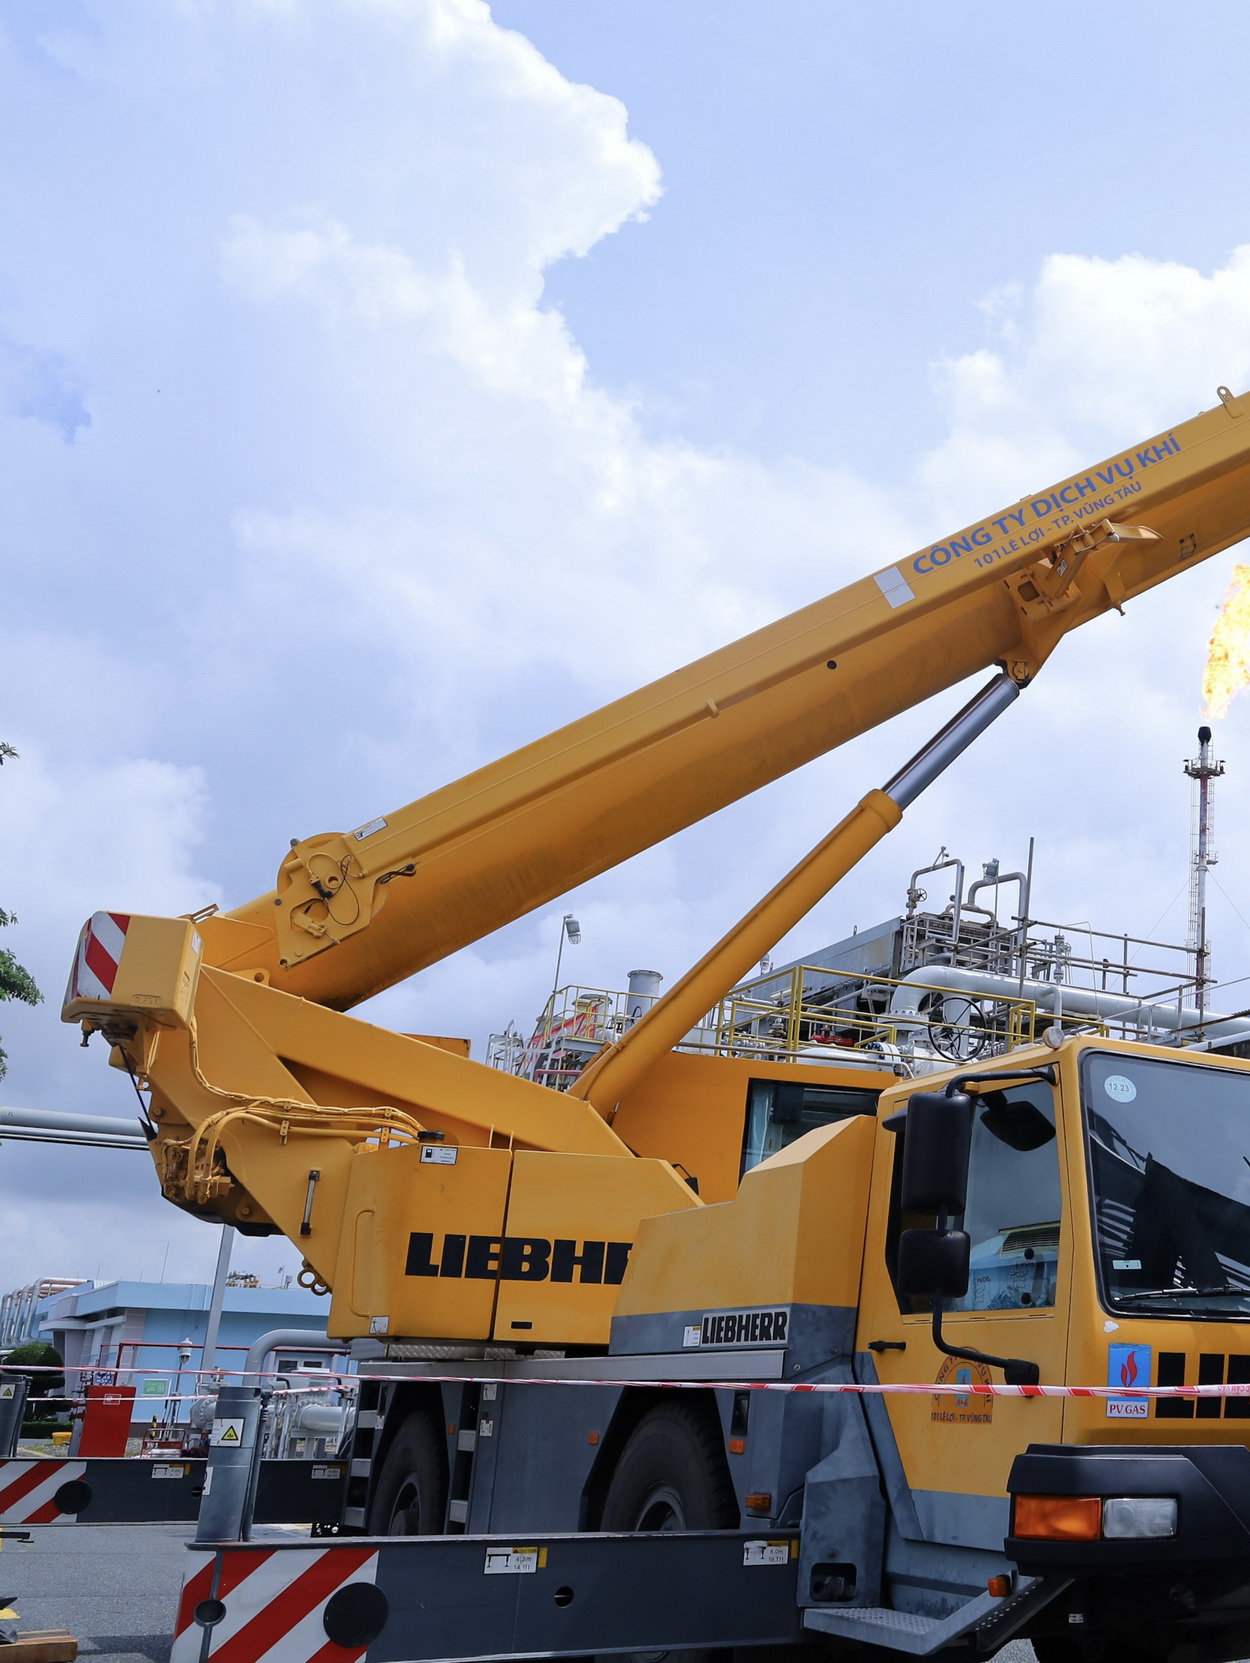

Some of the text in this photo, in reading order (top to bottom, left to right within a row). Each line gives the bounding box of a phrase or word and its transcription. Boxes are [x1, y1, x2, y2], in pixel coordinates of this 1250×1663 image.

[913, 433, 1182, 575] CÔNG TY DỊCH VỤ KHÍ
[974, 549, 1001, 569] 101
[999, 538, 1021, 556] LÊ
[1022, 528, 1046, 548] LỢI
[1052, 514, 1075, 531] TP.
[1073, 494, 1116, 519] VŨNG
[1114, 481, 1143, 501] TÀU
[702, 1312, 788, 1344] LIEBHERR
[1109, 1404, 1146, 1414] PV GAS
